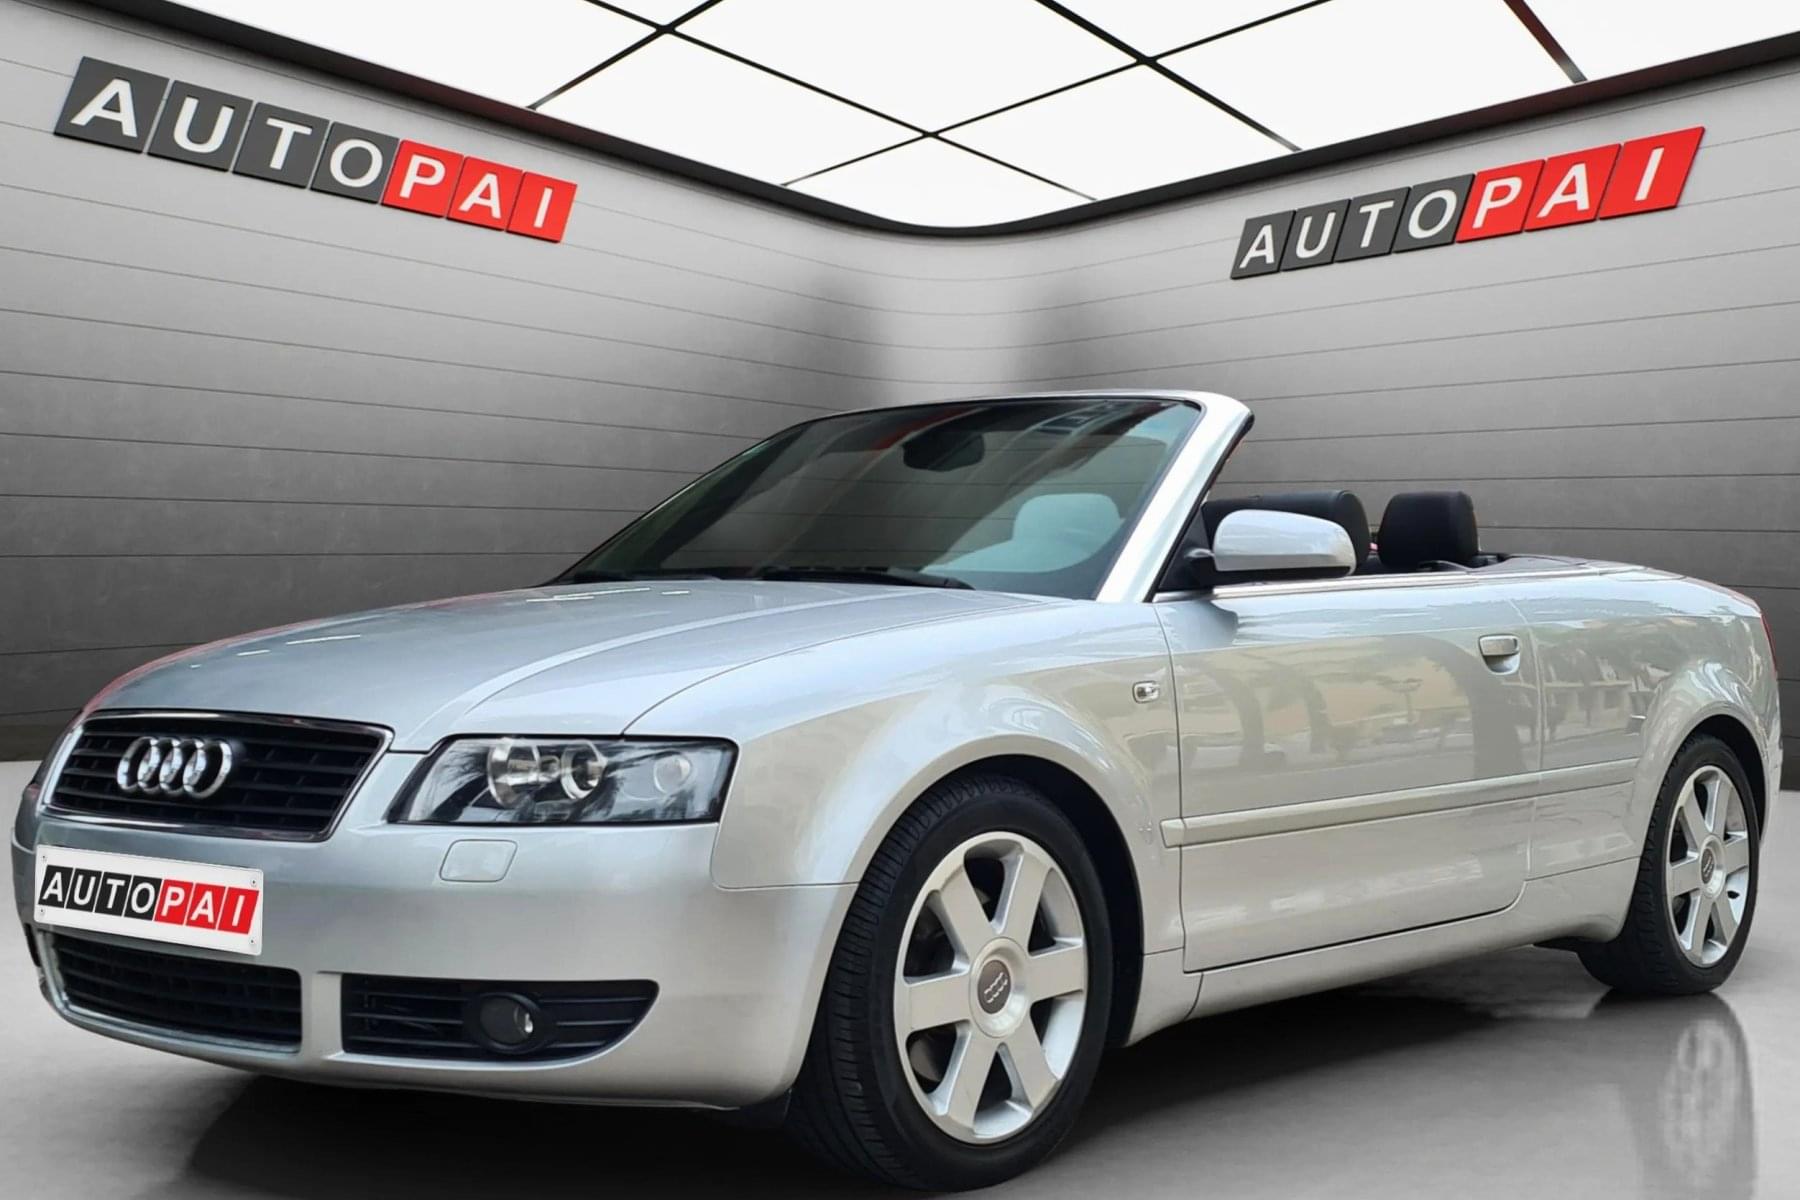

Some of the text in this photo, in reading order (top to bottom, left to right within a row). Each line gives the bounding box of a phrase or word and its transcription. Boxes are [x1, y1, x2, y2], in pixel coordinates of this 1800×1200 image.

[70, 78, 553, 228] AUTOPAI
[1239, 147, 1664, 268] AUTOPAI
[42, 871, 245, 927] AUTOPAI
